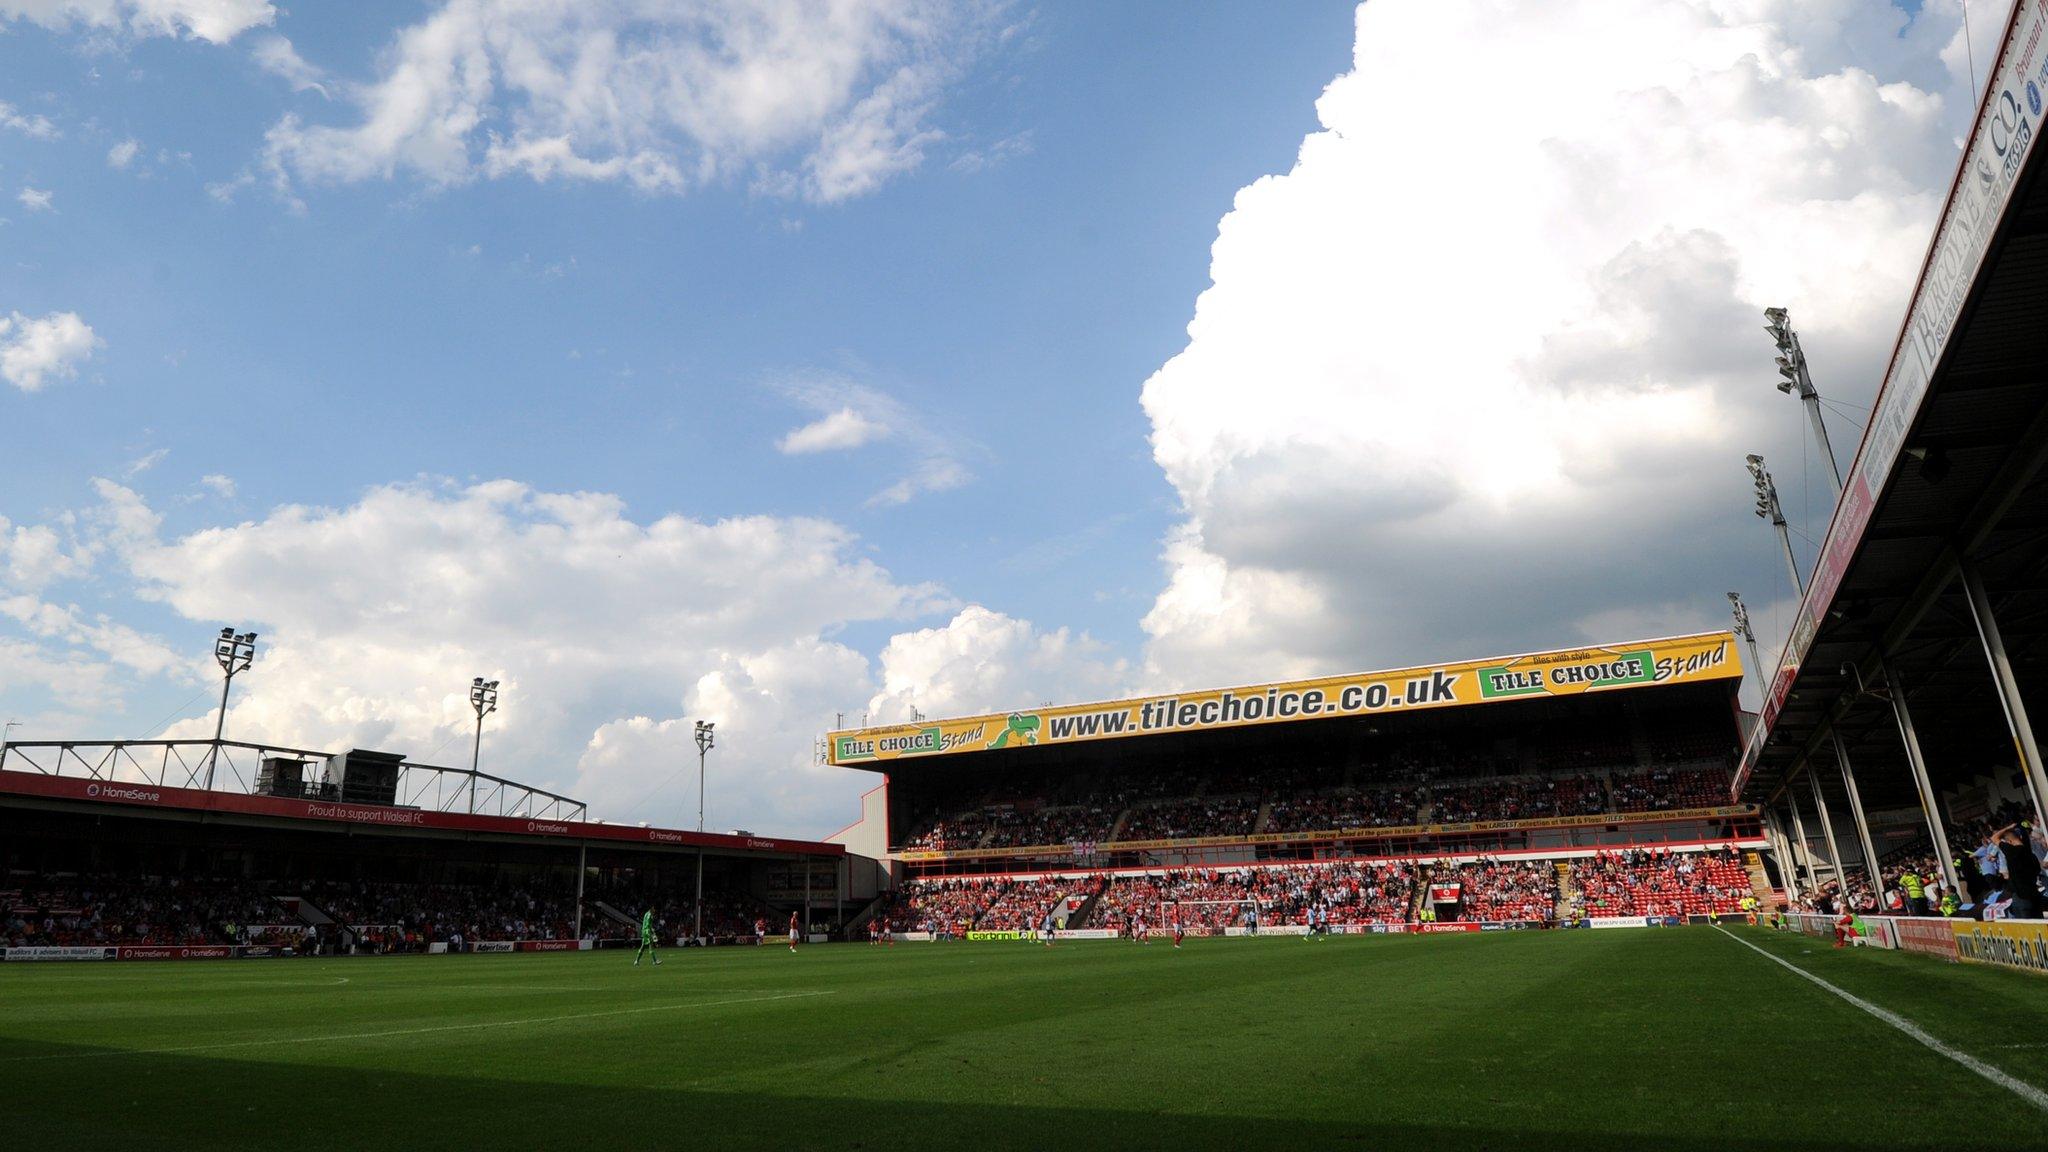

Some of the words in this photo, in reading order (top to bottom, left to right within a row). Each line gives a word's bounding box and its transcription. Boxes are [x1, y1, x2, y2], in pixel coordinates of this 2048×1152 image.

[1991, 89, 2021, 157] CO.
[2004, 121, 2031, 182] 616916
[1553, 653, 1570, 663] with
[1571, 652, 1591, 663] style
[1491, 671, 1543, 690] TILE
[1551, 660, 1643, 684] CHOICE
[1653, 641, 1726, 682] Stand
[1049, 671, 1457, 739] www.tilechoice.co.uk
[844, 740, 874, 754] TILE
[880, 735, 933, 751] CHOICE
[939, 721, 986, 751] Stand
[102, 786, 160, 801] HomeServe
[307, 804, 335, 816] Proud
[337, 807, 346, 818] to
[348, 809, 382, 821] support
[383, 811, 412, 823] Walsall
[413, 813, 424, 824] FC
[536, 823, 568, 833] HomeServe
[1331, 926, 1344, 934] sky
[1372, 925, 1385, 933] sky
[134, 950, 171, 958] HomeServe
[190, 949, 225, 957] HomeServe
